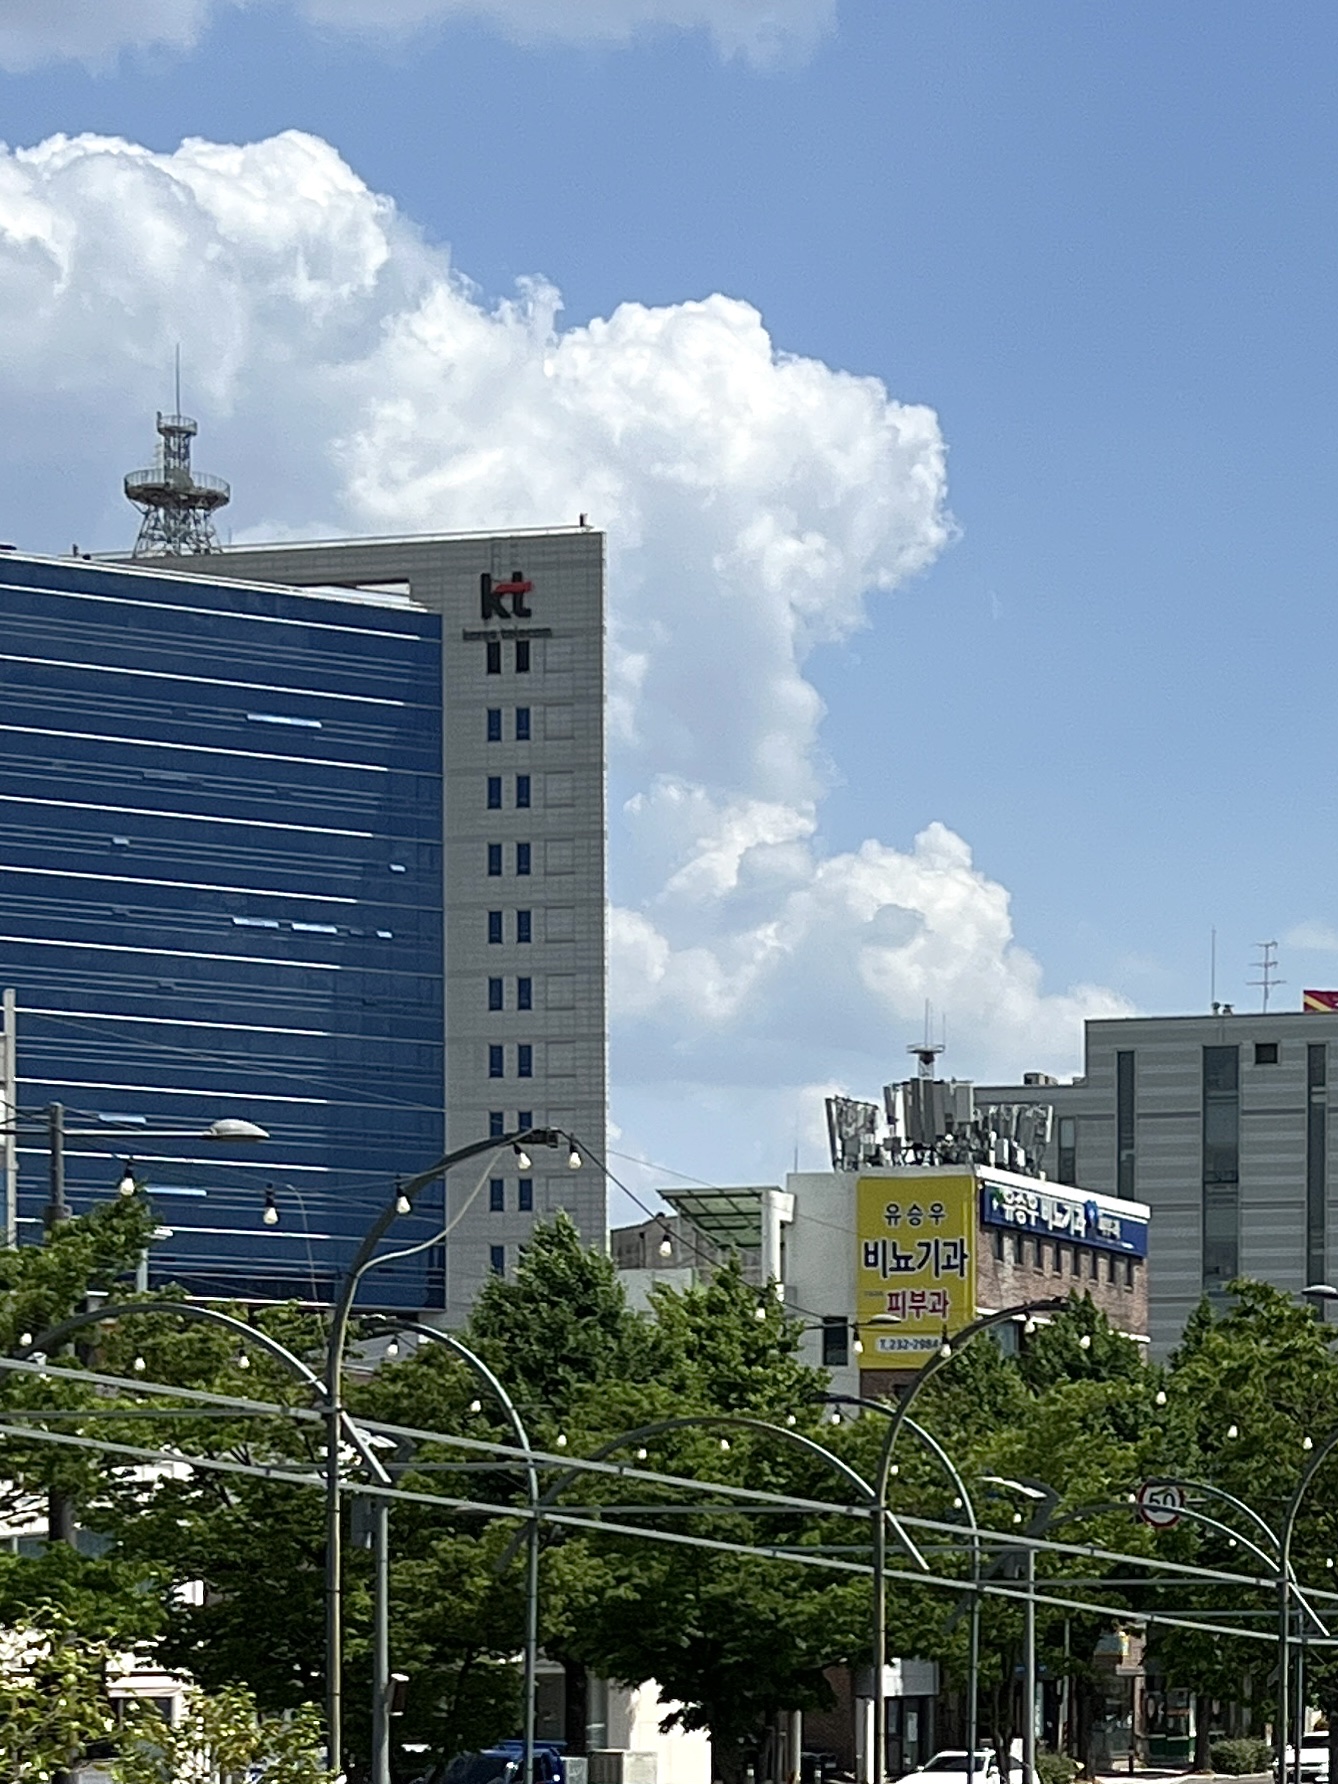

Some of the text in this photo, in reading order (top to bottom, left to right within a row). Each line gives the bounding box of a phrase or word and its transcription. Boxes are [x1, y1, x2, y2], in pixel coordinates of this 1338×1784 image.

[481, 571, 532, 619] kt
[884, 1203, 945, 1226] 유승우
[1002, 1187, 1039, 1226] 유승우
[864, 1238, 968, 1278] 비뇨기과
[887, 1289, 949, 1319] 피부과
[1149, 1492, 1176, 1513] 50
